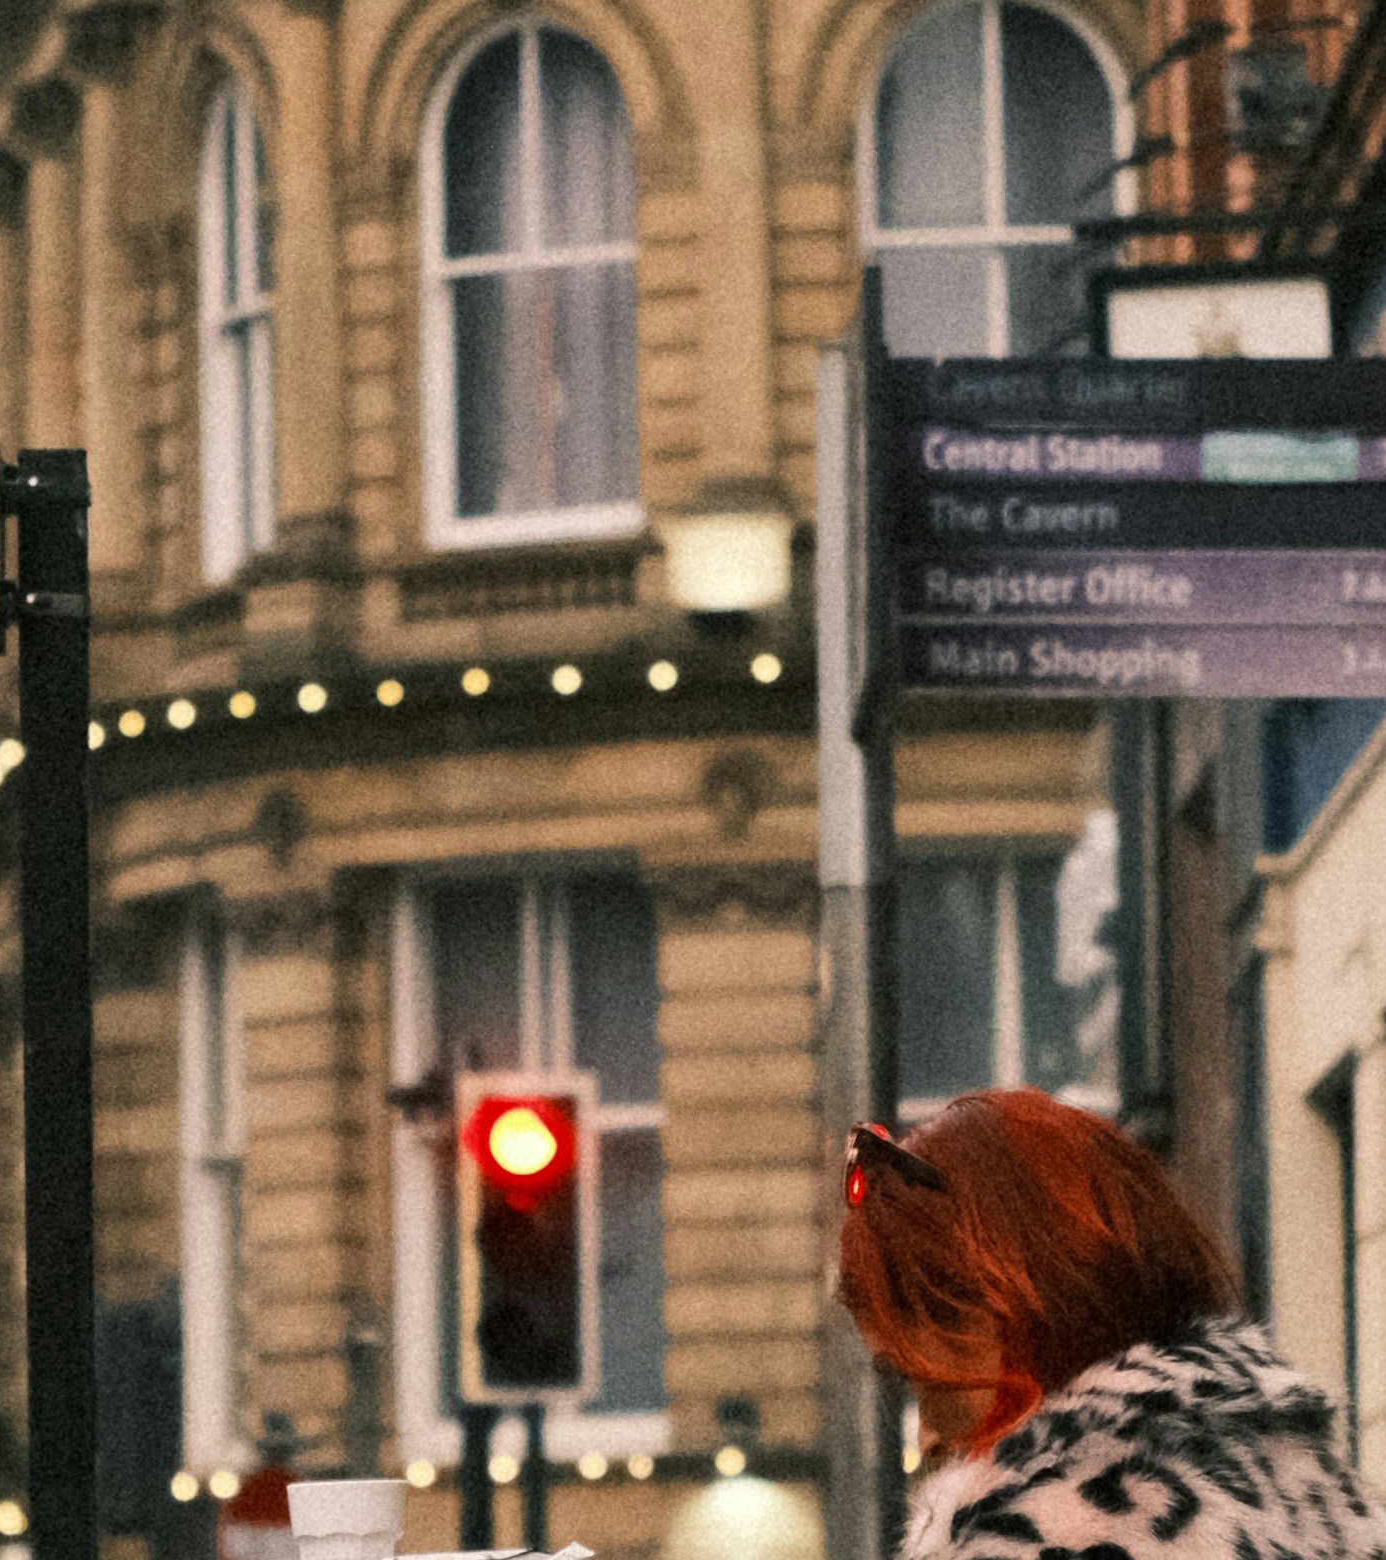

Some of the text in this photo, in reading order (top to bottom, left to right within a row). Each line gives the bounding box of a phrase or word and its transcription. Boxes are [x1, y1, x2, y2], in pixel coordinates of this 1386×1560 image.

[923, 431, 1162, 473] Central Station
[929, 496, 1119, 531] The Cavern
[926, 565, 1193, 613] Register Office
[929, 636, 1203, 685] Main Shopping
